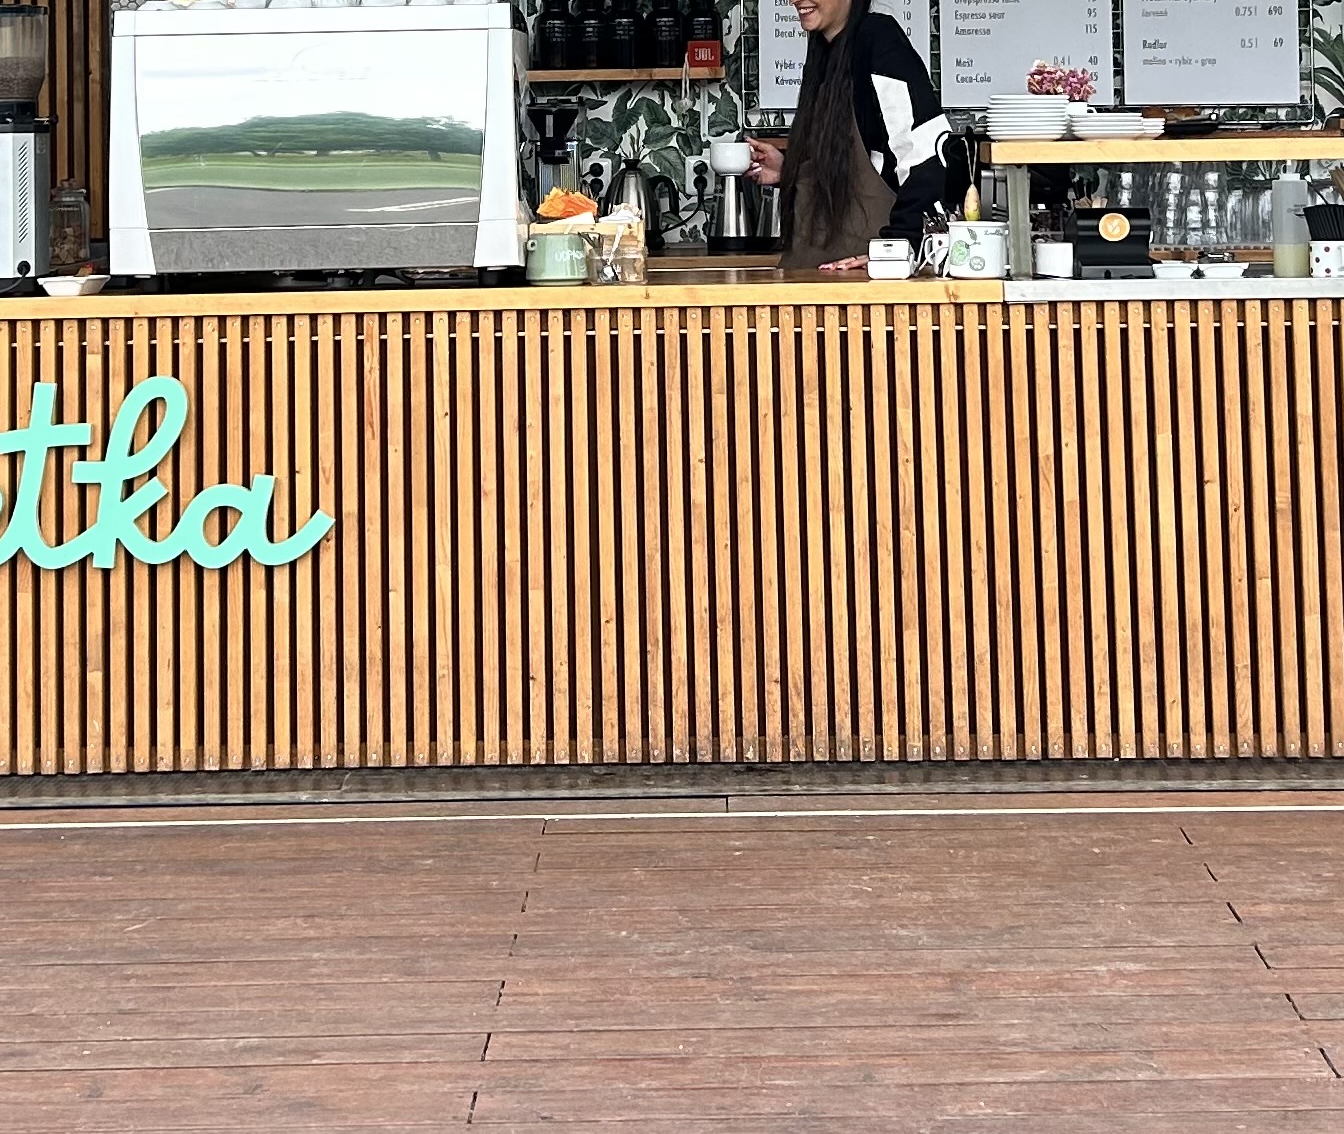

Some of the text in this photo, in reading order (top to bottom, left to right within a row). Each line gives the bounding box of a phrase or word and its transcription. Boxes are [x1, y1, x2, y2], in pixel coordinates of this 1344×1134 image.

[955, 10, 986, 22] Espresso
[1087, 8, 1097, 18] 95
[1268, 6, 1282, 15] 690
[903, 12, 911, 21] 10
[775, 28, 796, 38] Decaf
[1085, 24, 1097, 34] 115
[1143, 40, 1167, 49] Radler
[1274, 38, 1283, 48] 69
[694, 48, 715, 61] JBL
[1088, 56, 1098, 65] 40
[956, 73, 991, 83] Coca-Cola
